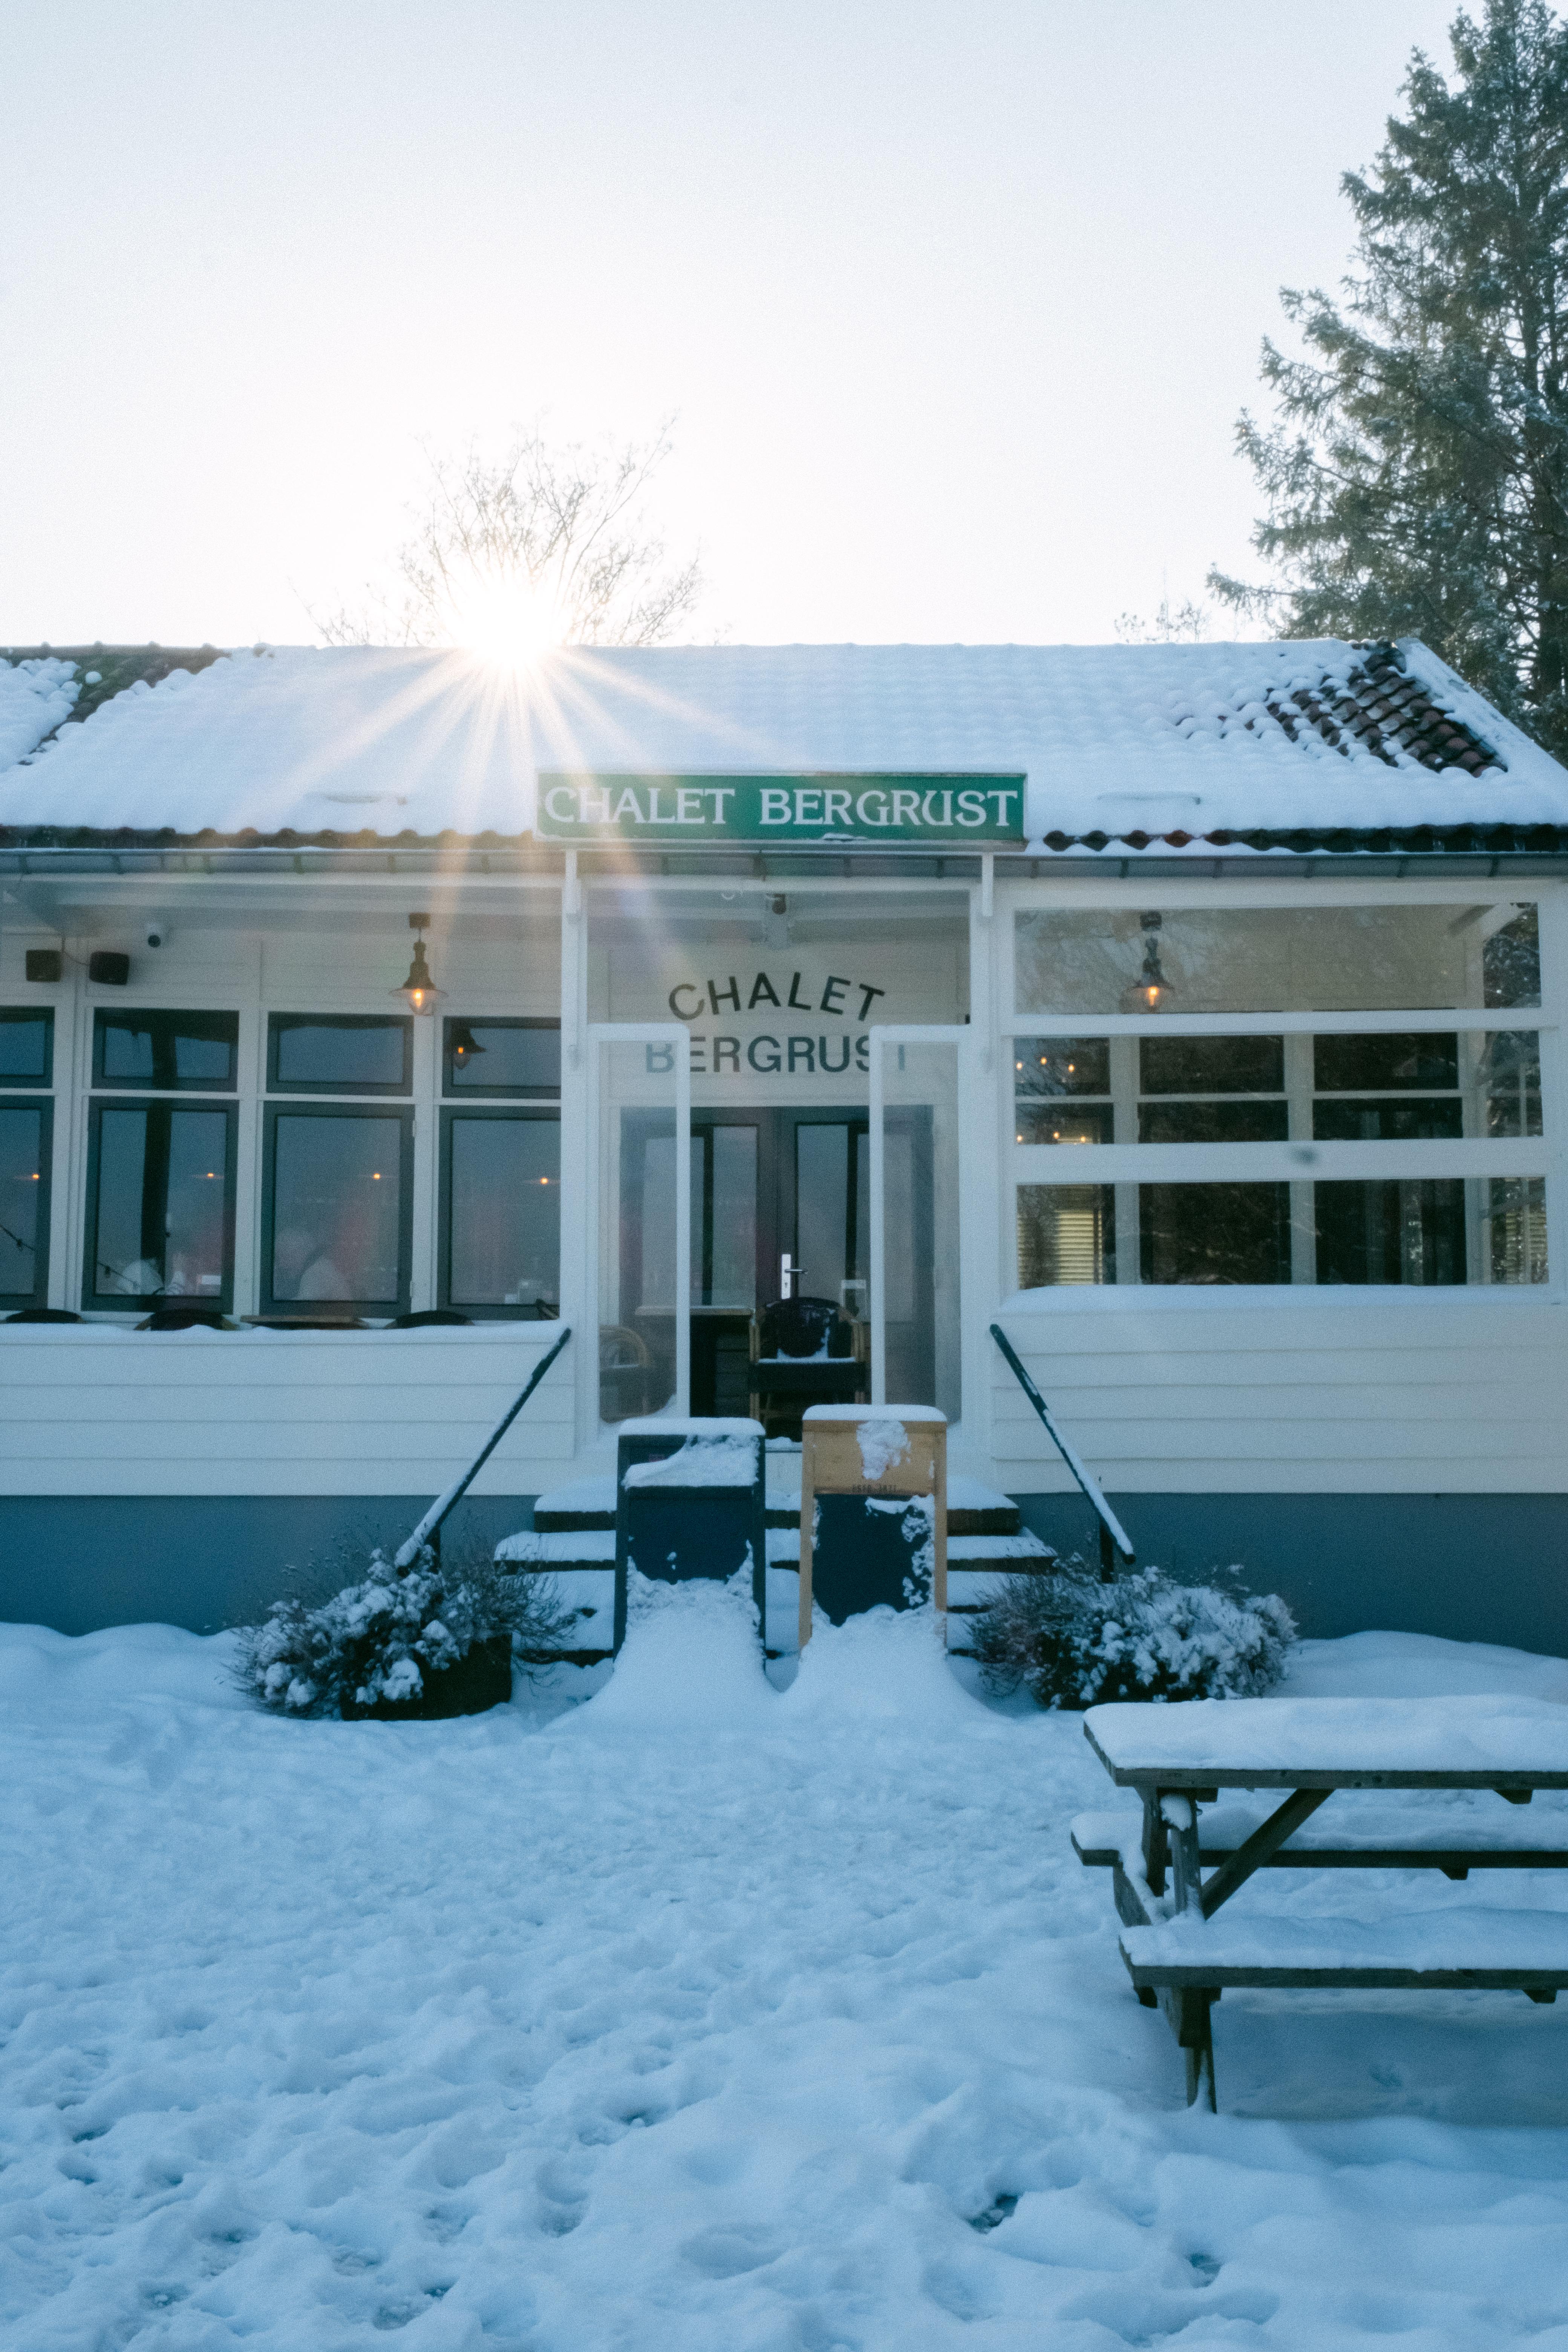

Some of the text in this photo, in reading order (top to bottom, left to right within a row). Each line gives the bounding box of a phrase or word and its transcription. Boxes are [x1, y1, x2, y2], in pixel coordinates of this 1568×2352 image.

[545, 787, 1018, 827] CHALET BERGRUST
[669, 972, 885, 1021] CHALET
